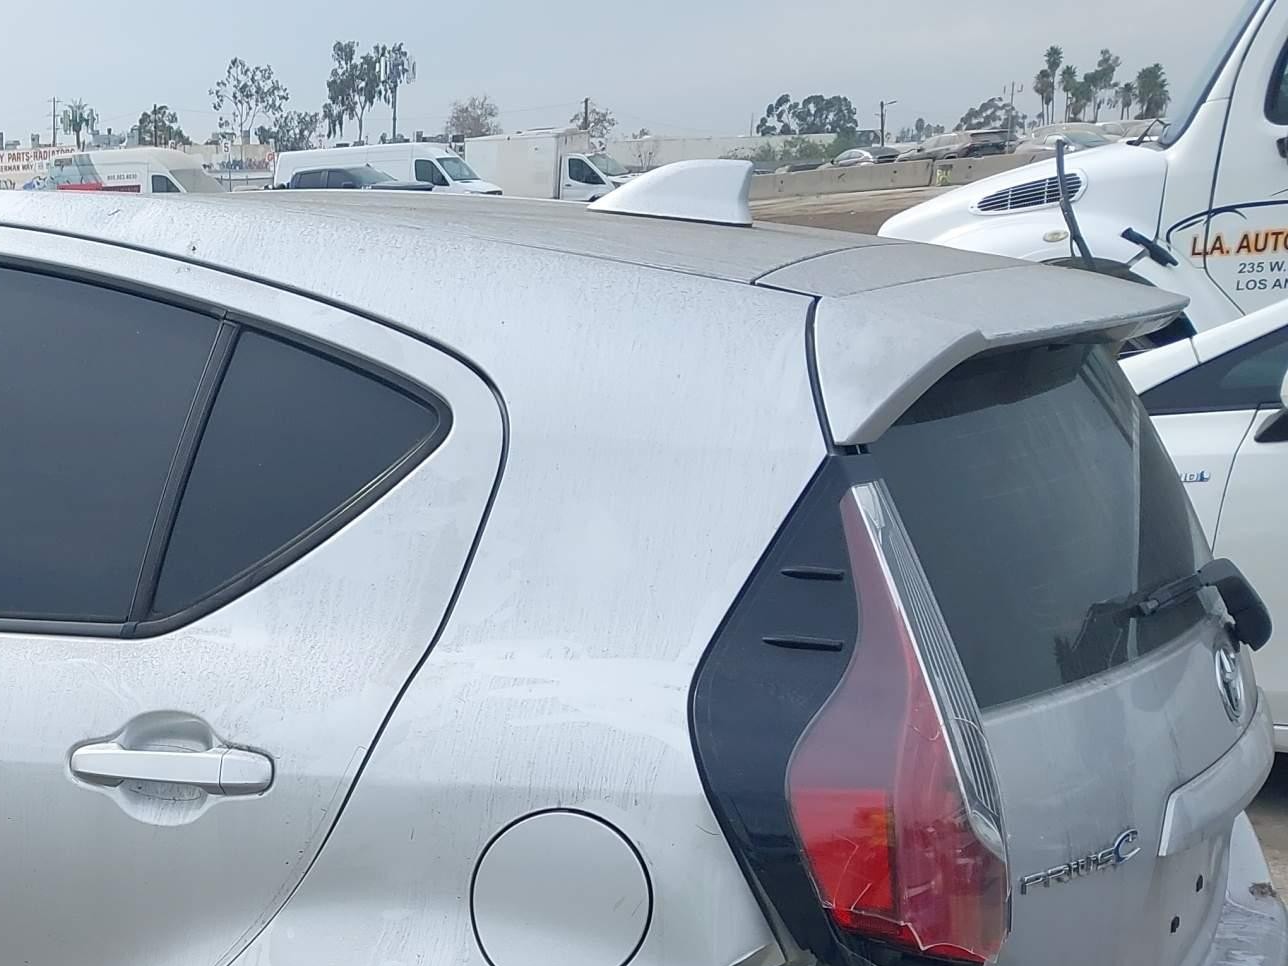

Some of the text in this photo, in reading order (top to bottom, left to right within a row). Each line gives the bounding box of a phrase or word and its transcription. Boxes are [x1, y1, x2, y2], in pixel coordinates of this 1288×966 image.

[1191, 235, 1230, 256] L.A.
[1237, 260, 1287, 274] 235 W.
[1235, 278, 1268, 291] LOS
